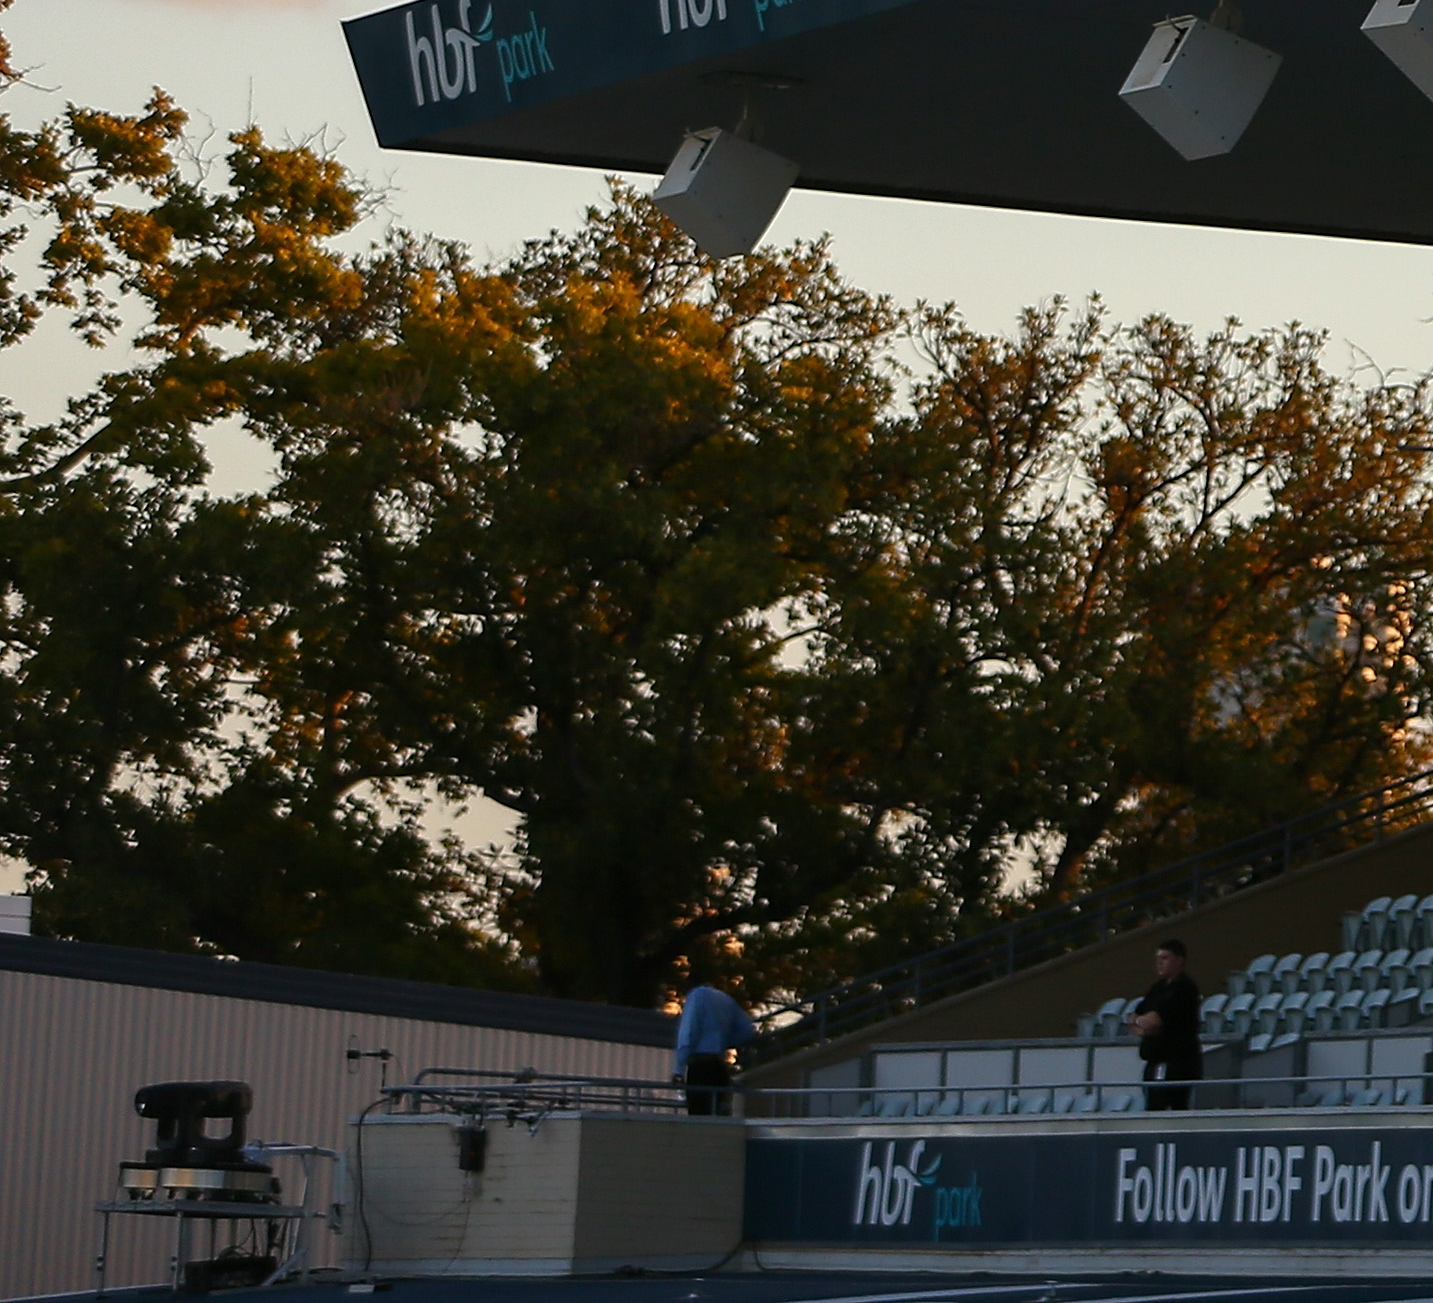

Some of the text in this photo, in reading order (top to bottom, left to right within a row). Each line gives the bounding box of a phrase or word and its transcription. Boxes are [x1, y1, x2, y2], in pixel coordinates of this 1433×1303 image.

[496, 11, 554, 101] park
[853, 1138, 982, 1240] hbf park
[1117, 1144, 1226, 1222] Follow
[1236, 1147, 1304, 1221] HBF
[1313, 1141, 1389, 1221] Park
